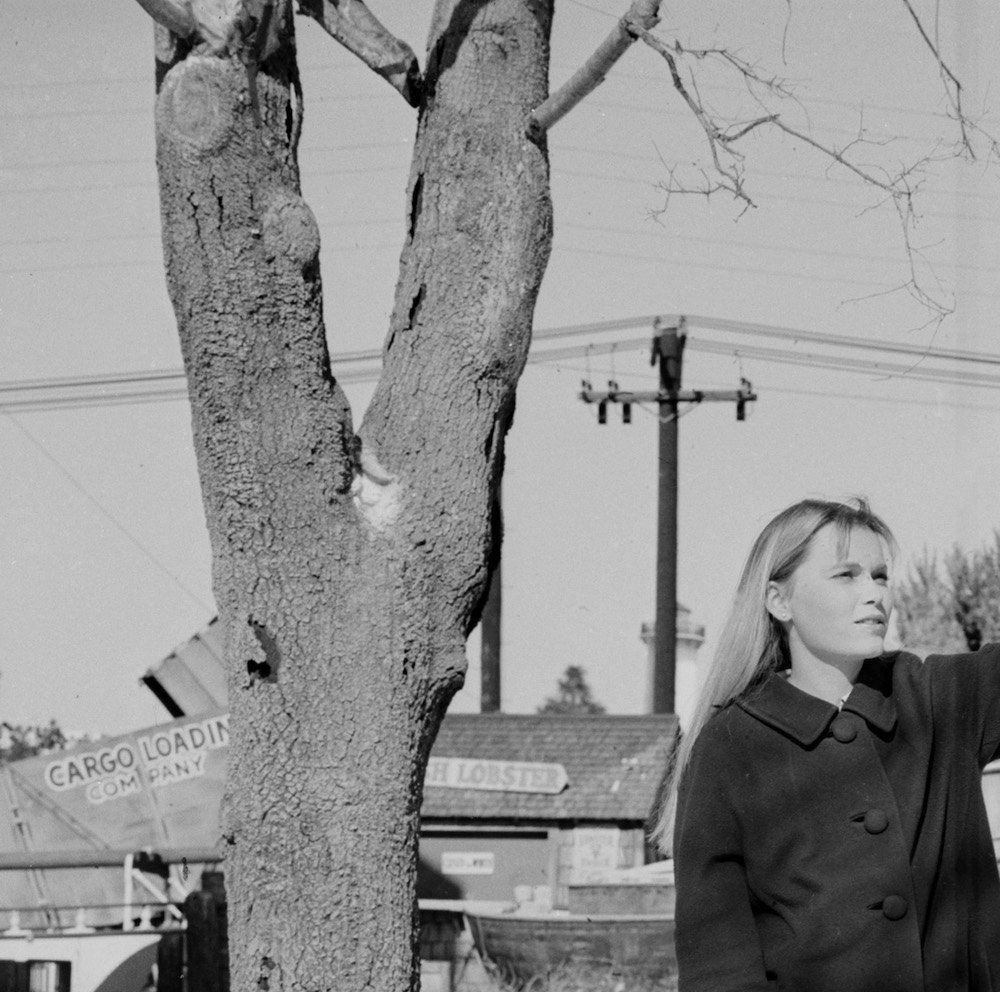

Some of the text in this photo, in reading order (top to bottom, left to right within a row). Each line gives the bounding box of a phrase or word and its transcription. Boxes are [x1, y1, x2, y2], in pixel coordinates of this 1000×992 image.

[49, 720, 230, 787] CARGO LOADIN
[457, 763, 559, 788] LOBSTER
